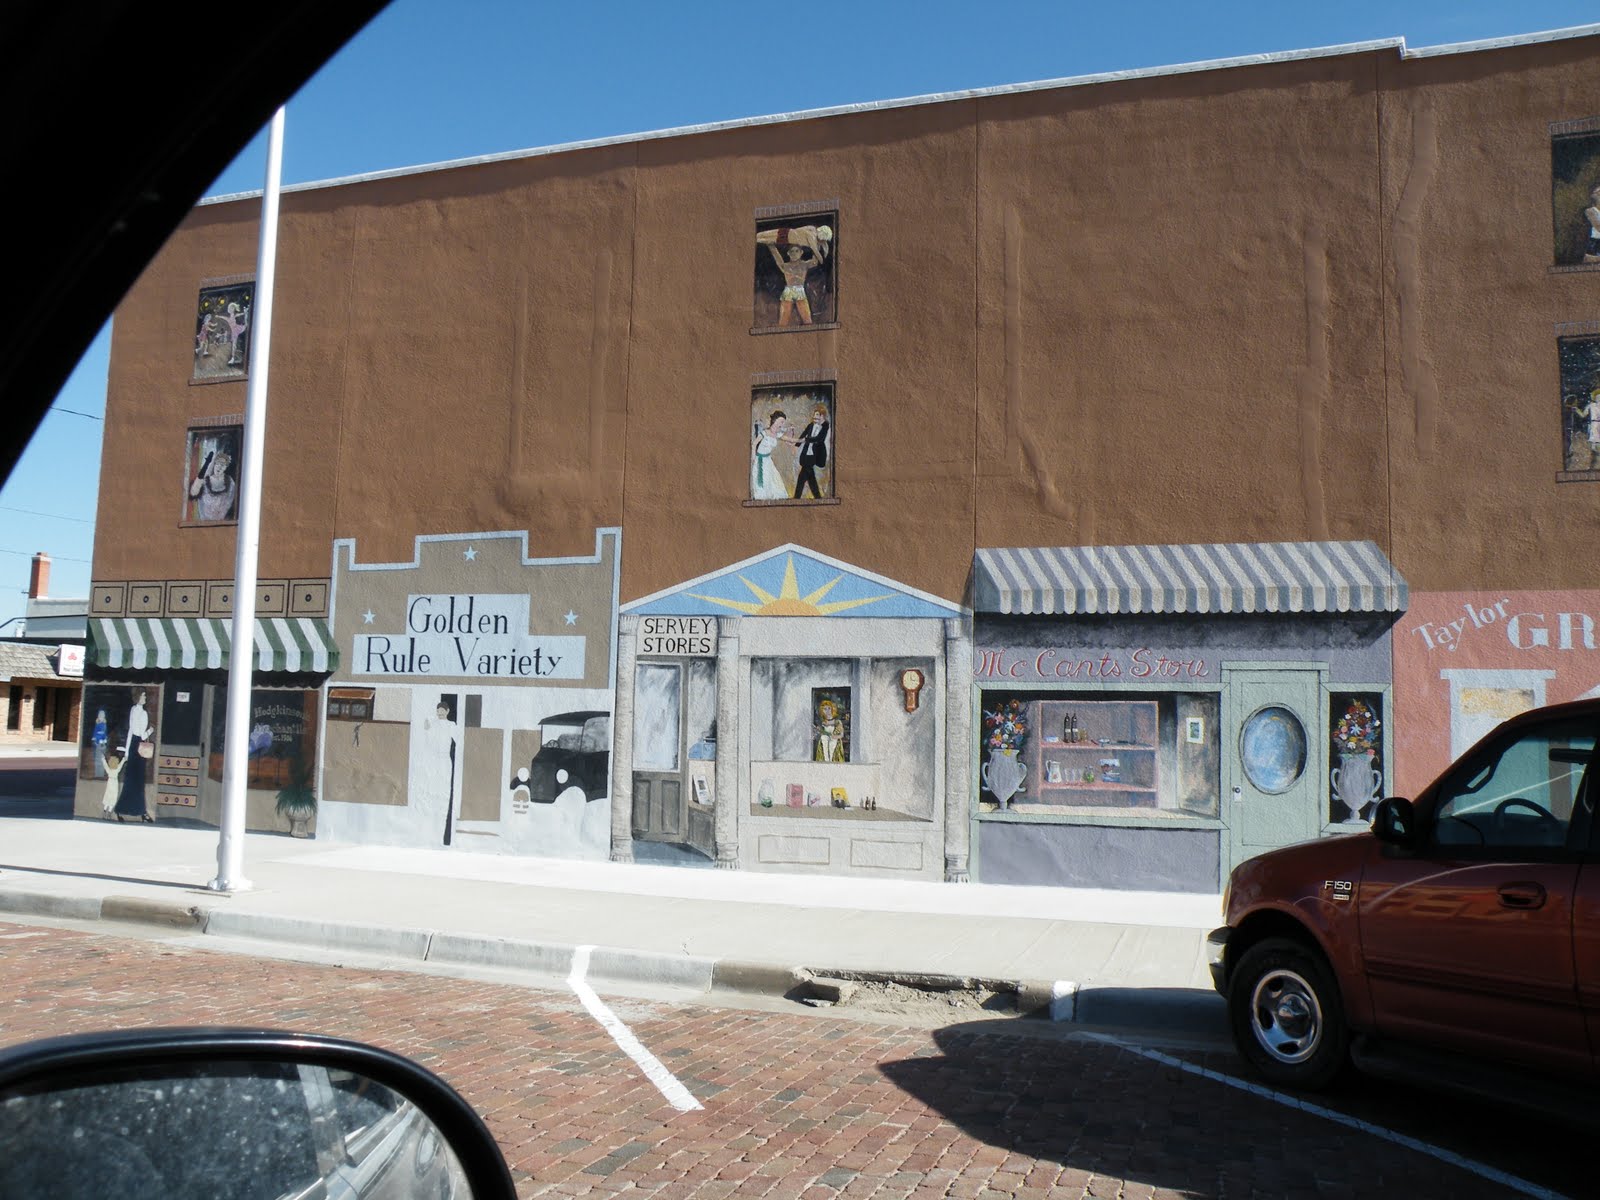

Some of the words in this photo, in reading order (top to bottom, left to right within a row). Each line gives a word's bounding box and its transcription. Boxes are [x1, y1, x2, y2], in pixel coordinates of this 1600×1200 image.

[408, 596, 509, 635] Golden
[644, 617, 713, 634] SERVEY
[1411, 598, 1510, 652] Taylor
[365, 636, 431, 673] Rule
[453, 637, 563, 676] Variety
[643, 637, 711, 653] STORES
[973, 648, 1028, 678] Mc
[1035, 648, 1123, 678] Cants
[1129, 646, 1209, 678] Store
[1324, 880, 1352, 890] F150
